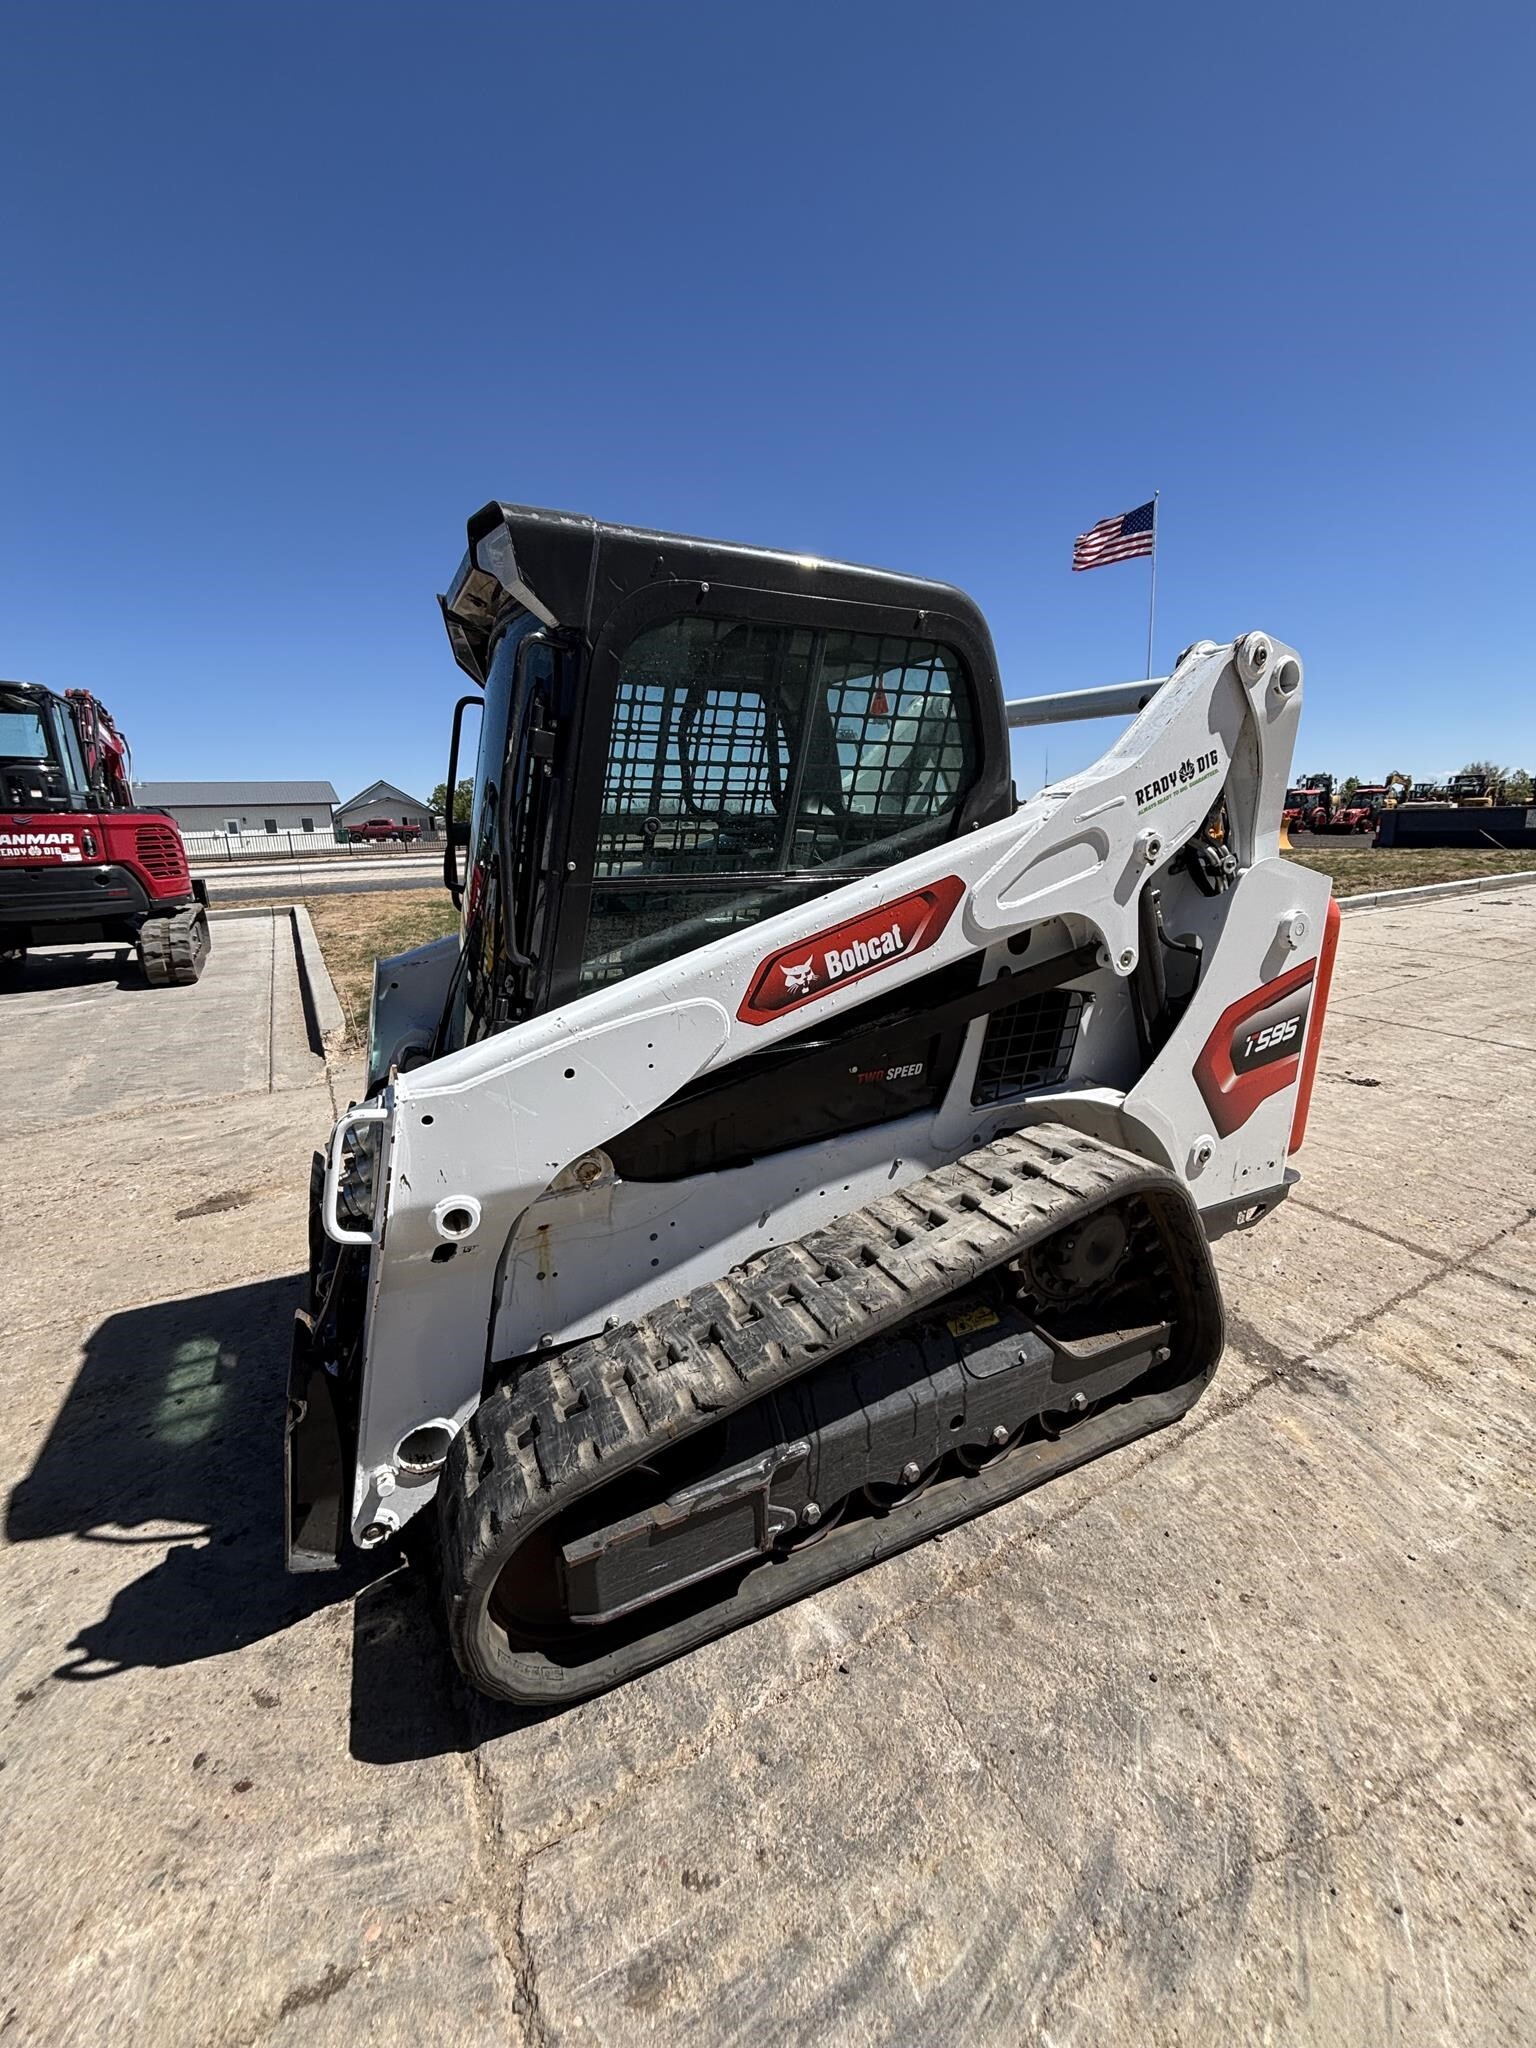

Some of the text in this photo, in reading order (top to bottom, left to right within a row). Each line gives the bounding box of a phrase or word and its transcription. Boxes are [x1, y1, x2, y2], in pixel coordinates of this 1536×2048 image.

[1135, 749, 1218, 806] READY DIG
[0, 833, 75, 845] ANMAR
[0, 847, 27, 857] EADY
[43, 846, 62, 856] DIG
[823, 923, 904, 980] Bobcat
[857, 1062, 924, 1085] TWO SPEED
